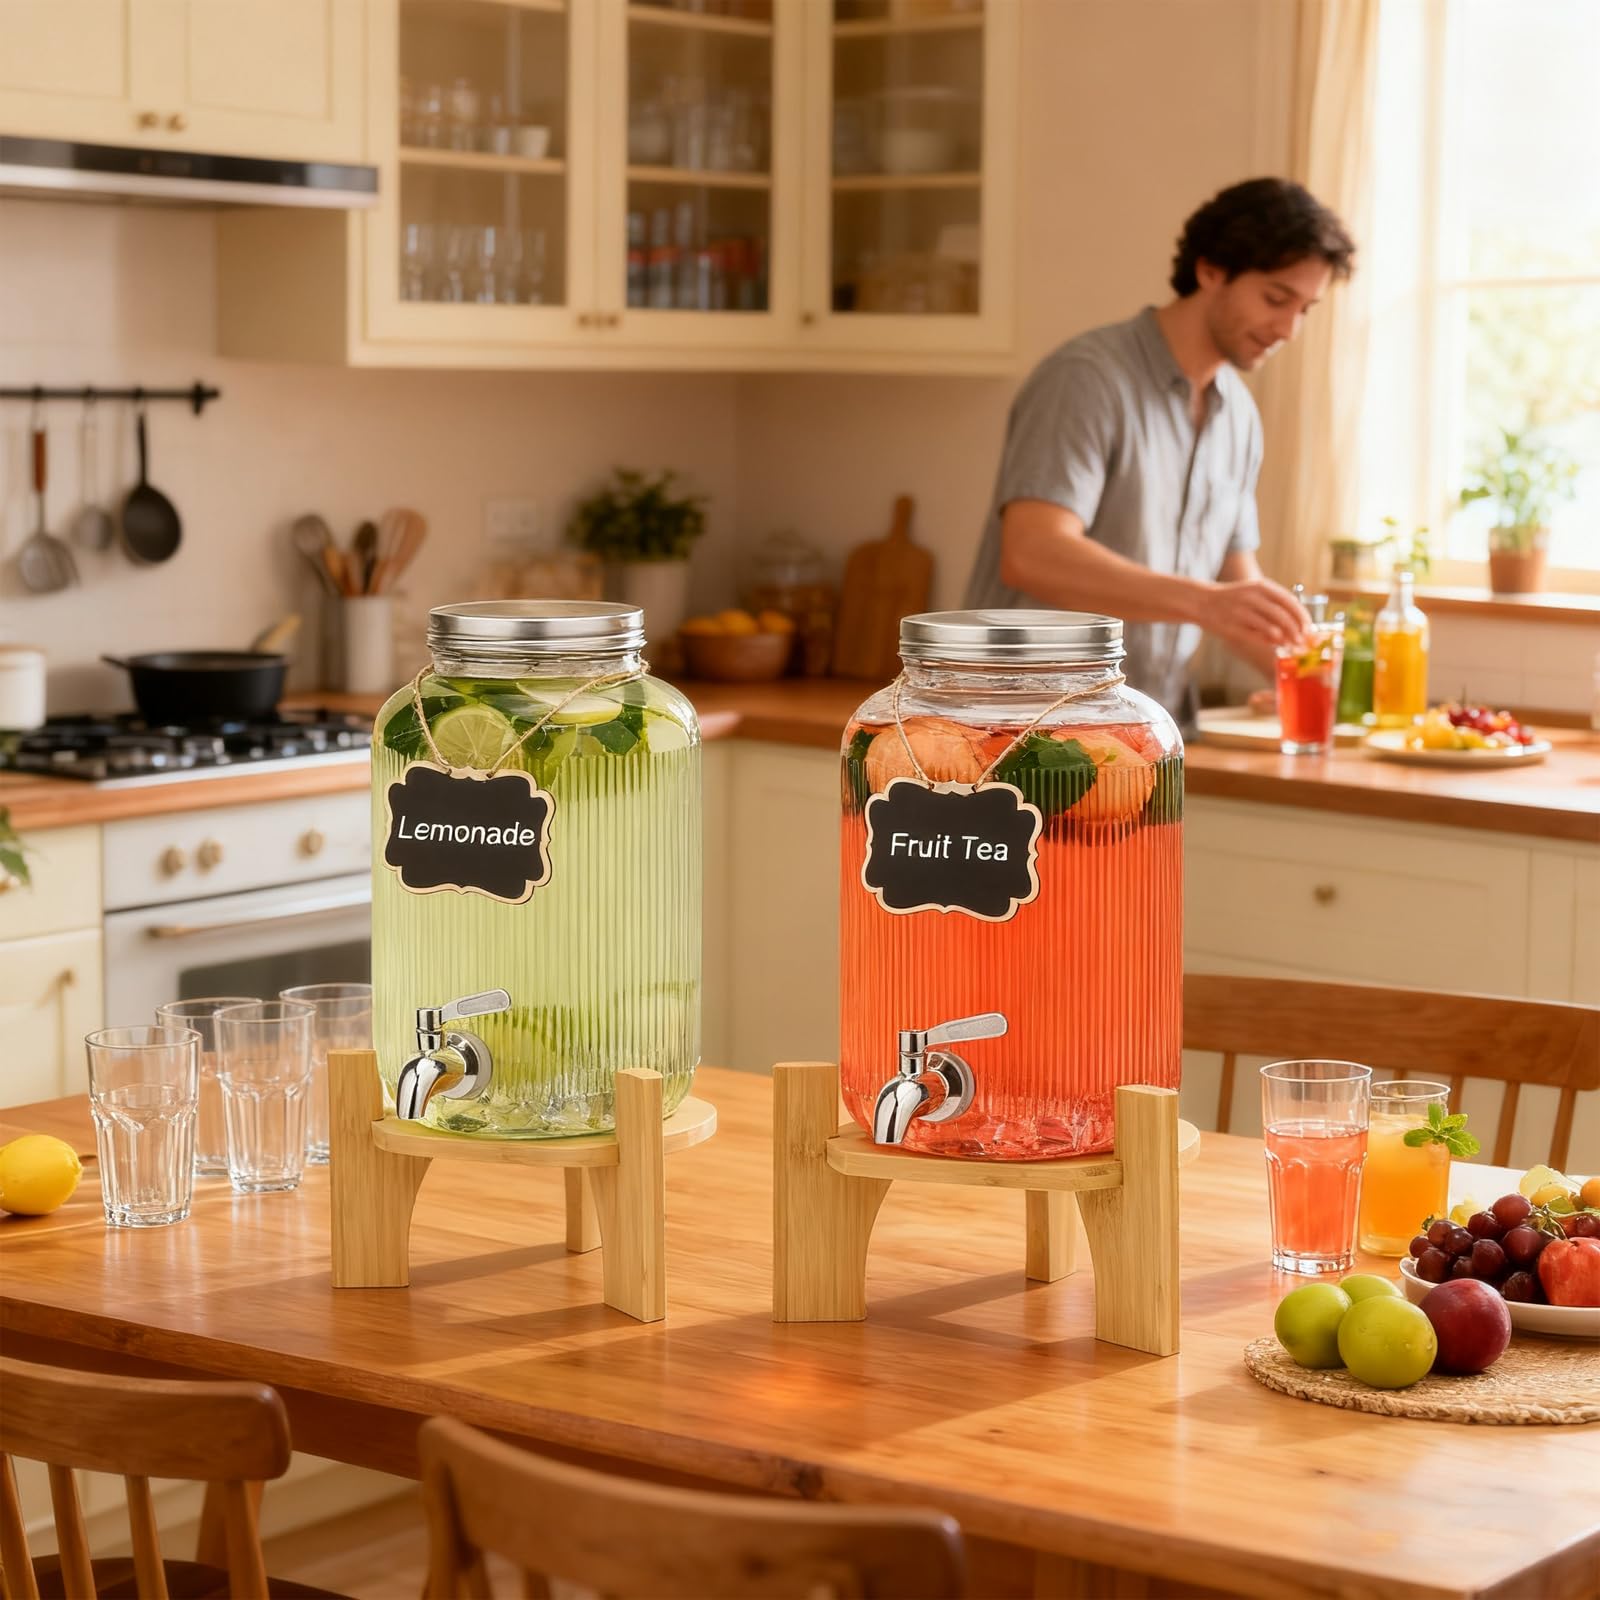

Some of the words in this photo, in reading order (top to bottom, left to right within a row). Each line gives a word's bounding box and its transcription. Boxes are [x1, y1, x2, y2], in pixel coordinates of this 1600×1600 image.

[397, 815, 536, 846] Lemonade
[890, 832, 953, 859] Fruit
[961, 835, 1009, 862] Tea
